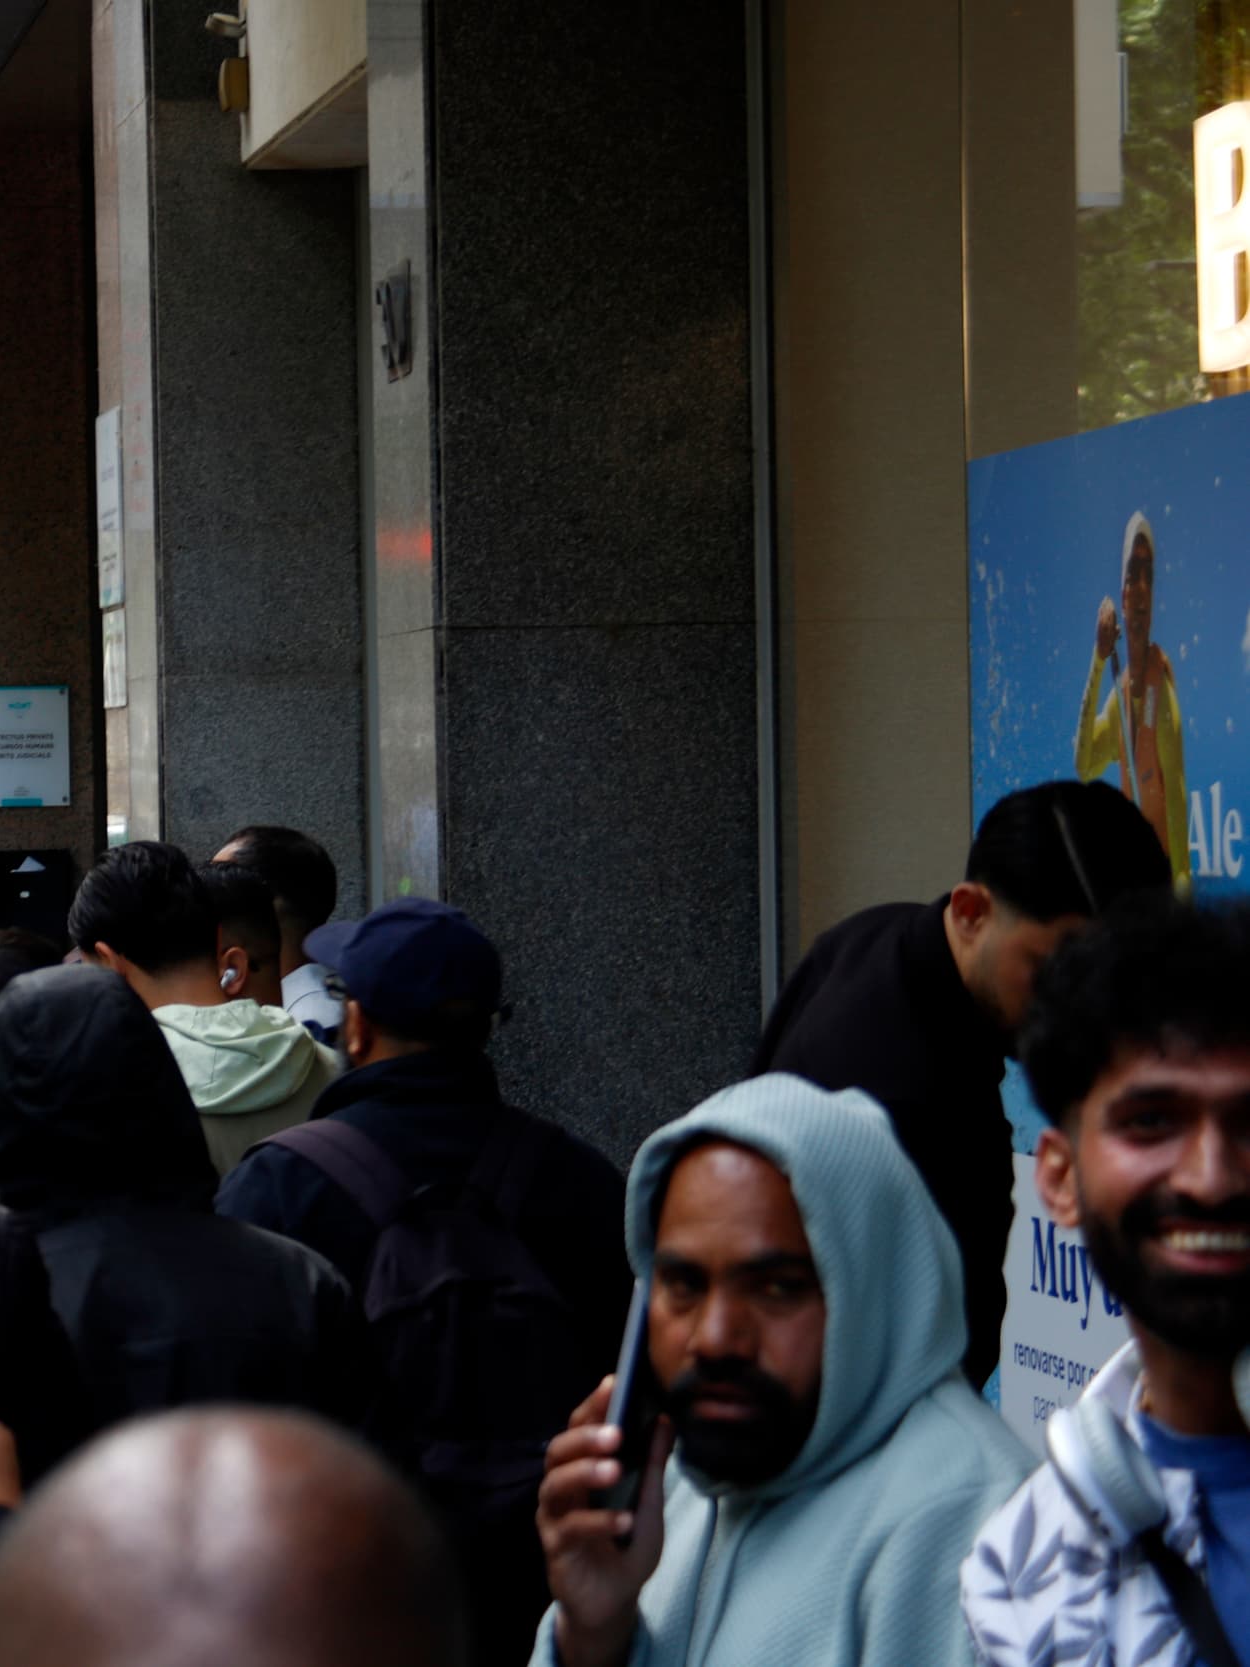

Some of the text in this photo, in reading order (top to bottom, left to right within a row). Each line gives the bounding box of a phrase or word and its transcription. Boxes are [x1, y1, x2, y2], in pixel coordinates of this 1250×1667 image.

[1188, 781, 1243, 878] Ale
[1030, 1216, 1094, 1331] Muy
[1013, 1342, 1066, 1380] renovarse
[1067, 1360, 1087, 1391] por
